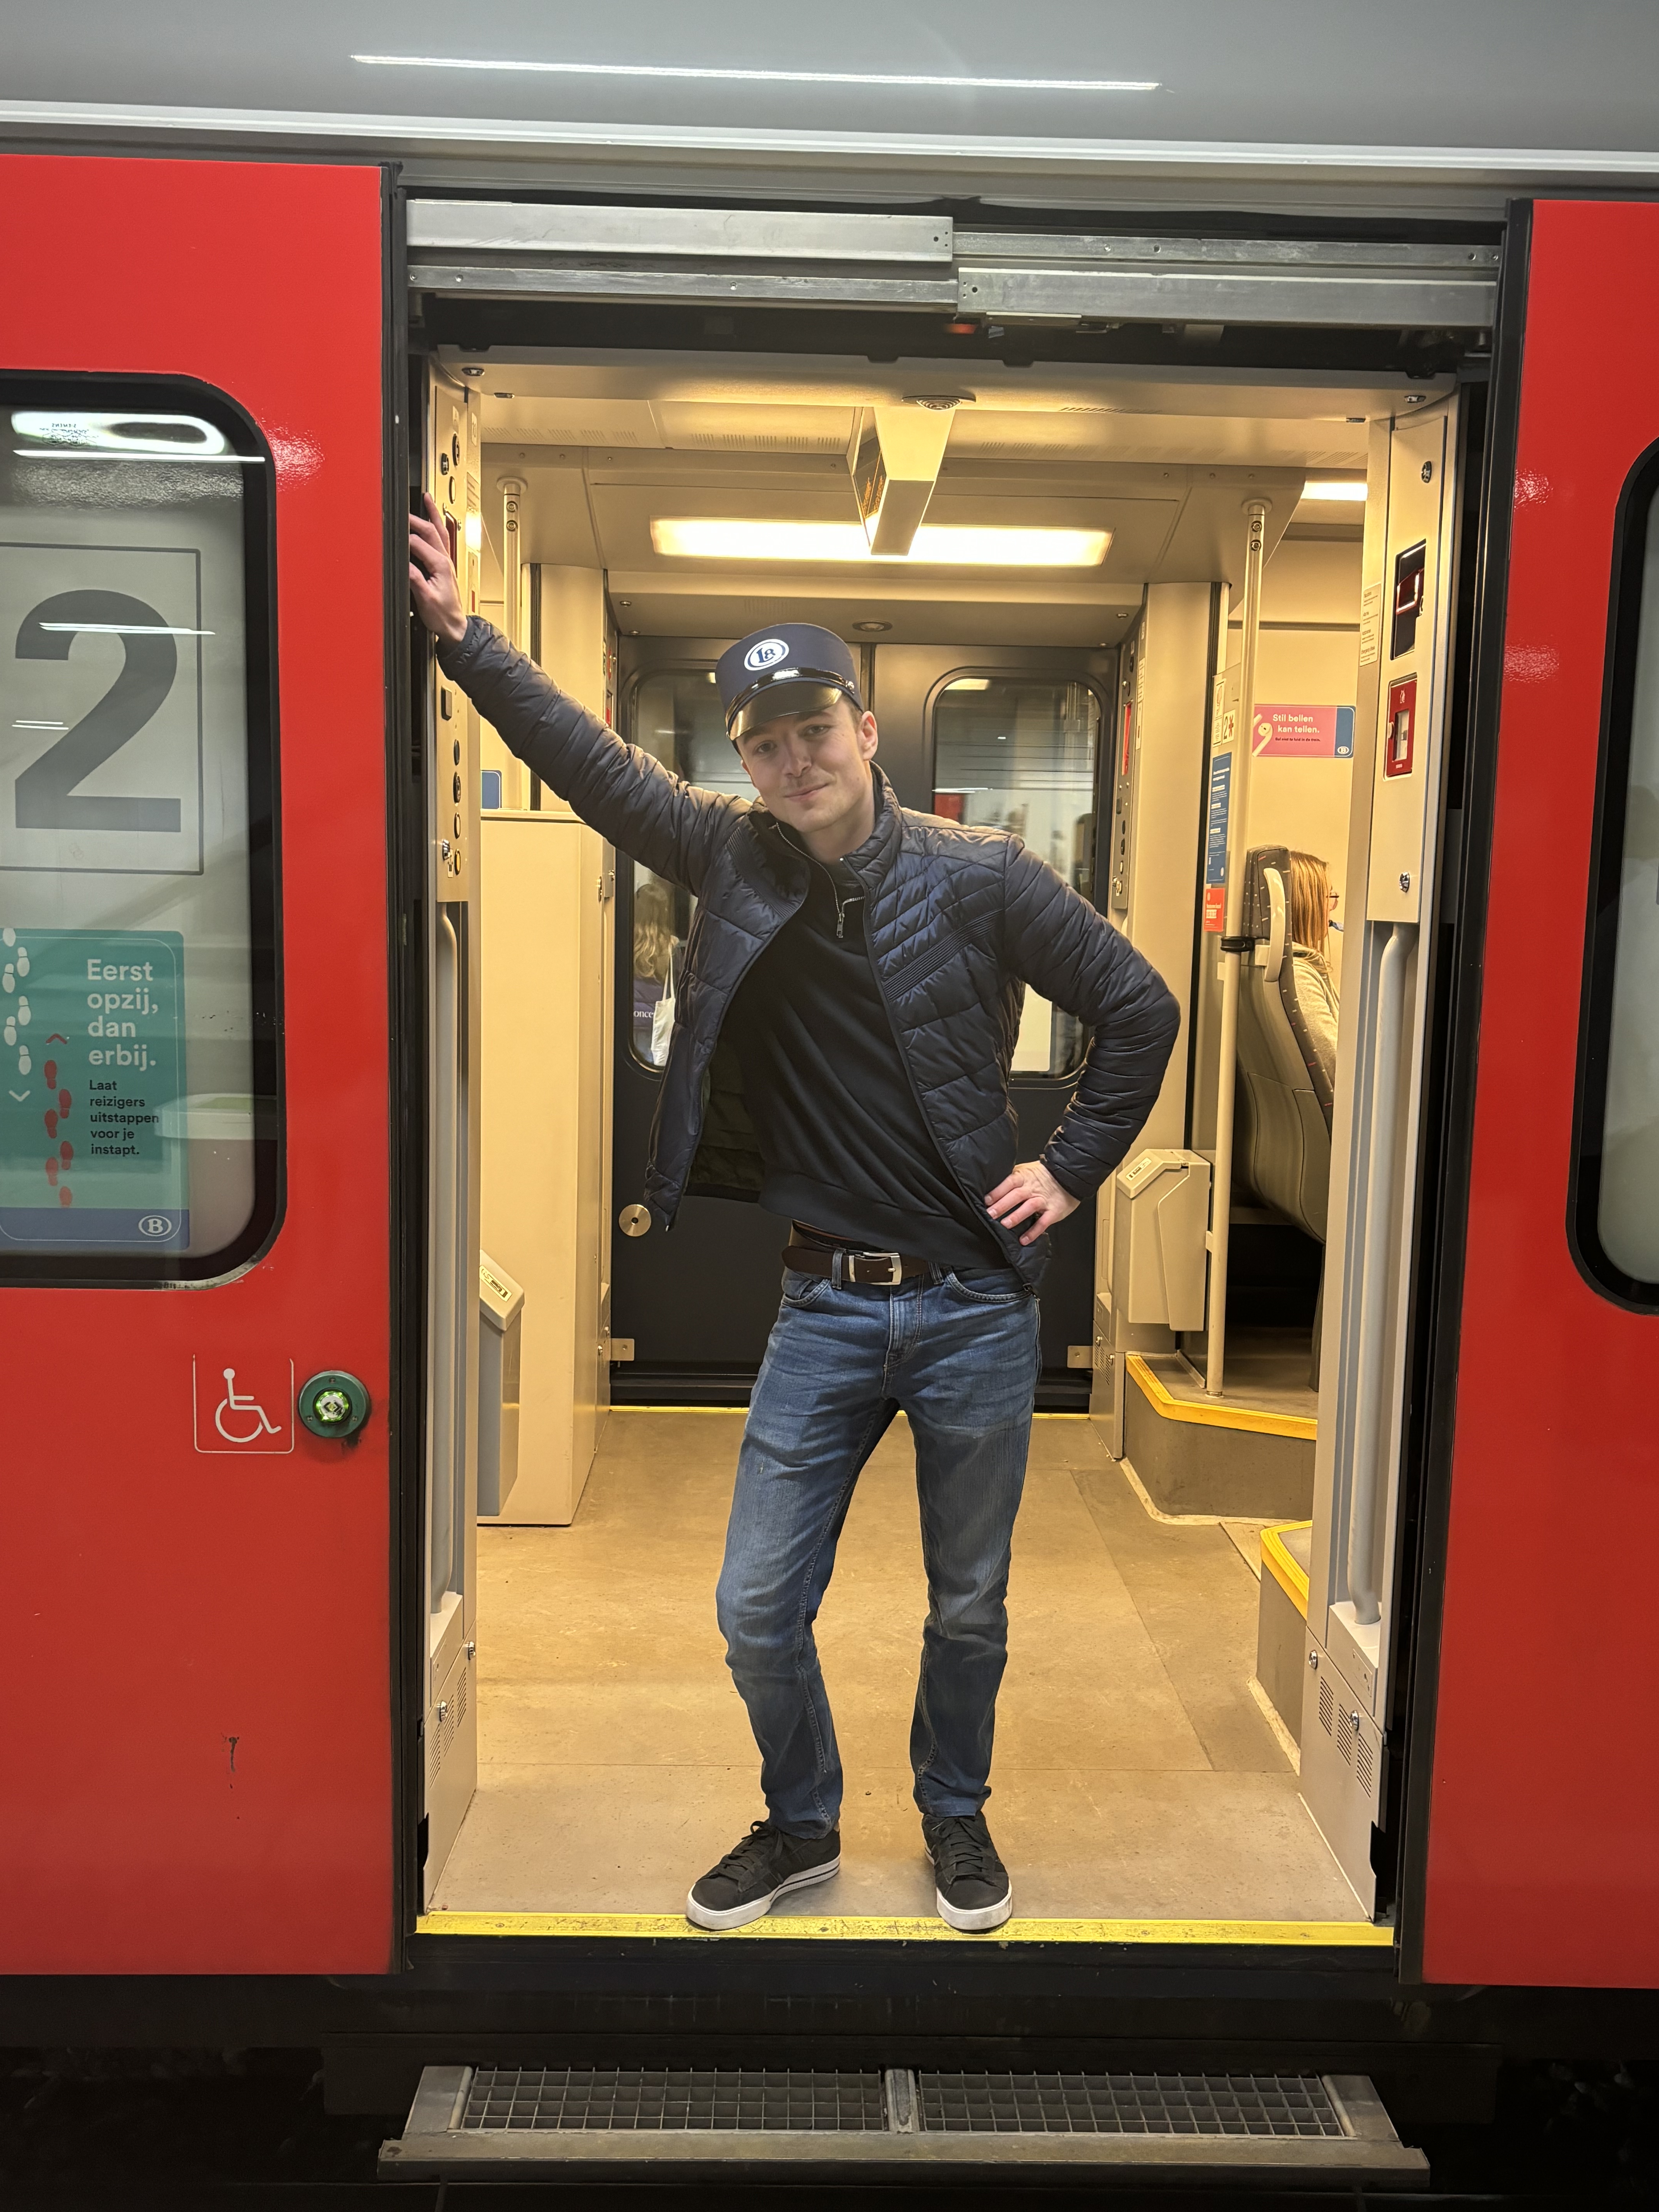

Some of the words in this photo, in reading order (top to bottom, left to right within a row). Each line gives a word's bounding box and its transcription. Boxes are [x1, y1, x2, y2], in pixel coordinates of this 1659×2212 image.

[15, 589, 181, 833] 2
[1272, 714, 1286, 722] Stil
[1288, 714, 1314, 722] bellen
[1278, 725, 1292, 733] kan
[1294, 725, 1320, 733] tellen.
[87, 958, 154, 981] Eerst
[87, 987, 159, 1015] opzij,
[88, 1015, 136, 1037] dan
[88, 1044, 156, 1072] erbij.
[89, 1079, 117, 1091] Laat
[90, 1096, 145, 1109] reizigers
[90, 1112, 159, 1125] uitstappen
[90, 1130, 120, 1139] voor
[122, 1128, 135, 1141] je
[91, 1143, 140, 1157] instapt.
